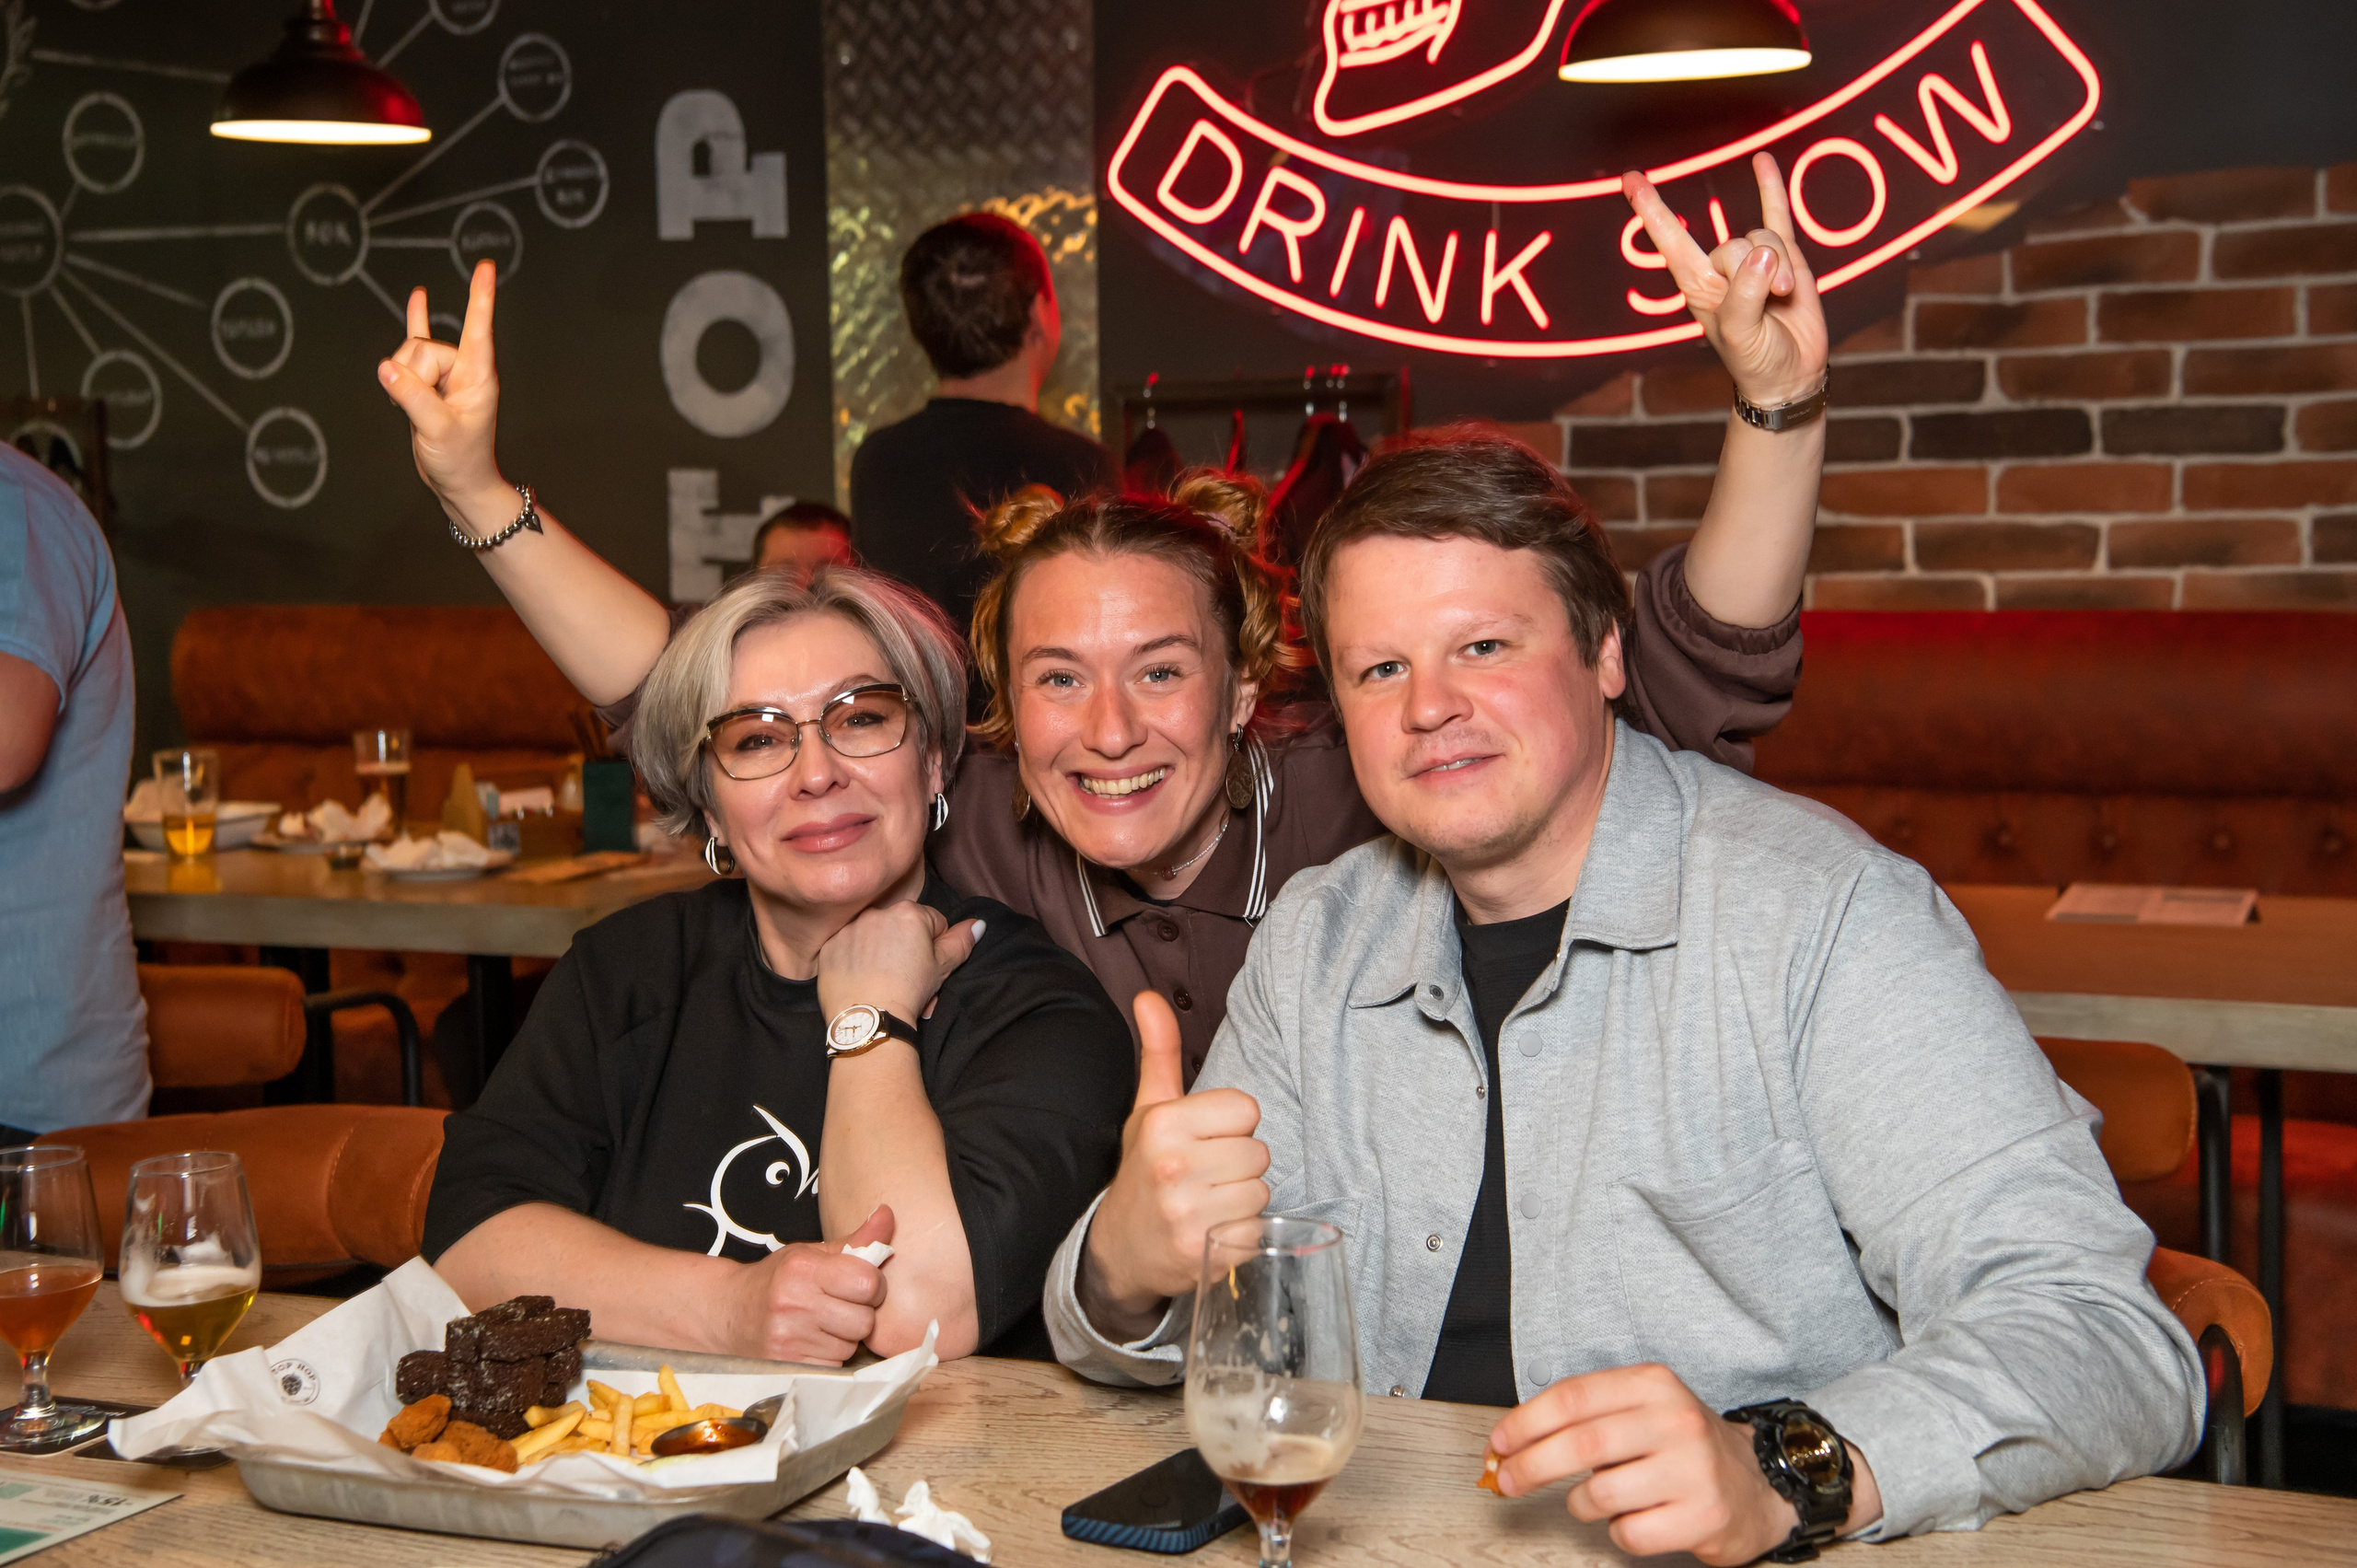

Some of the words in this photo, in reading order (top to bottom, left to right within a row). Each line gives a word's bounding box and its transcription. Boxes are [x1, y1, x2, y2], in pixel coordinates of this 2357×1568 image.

[656, 89, 795, 602] TOP
[1156, 117, 1552, 331] DRINK
[1620, 41, 2013, 316] SOW
